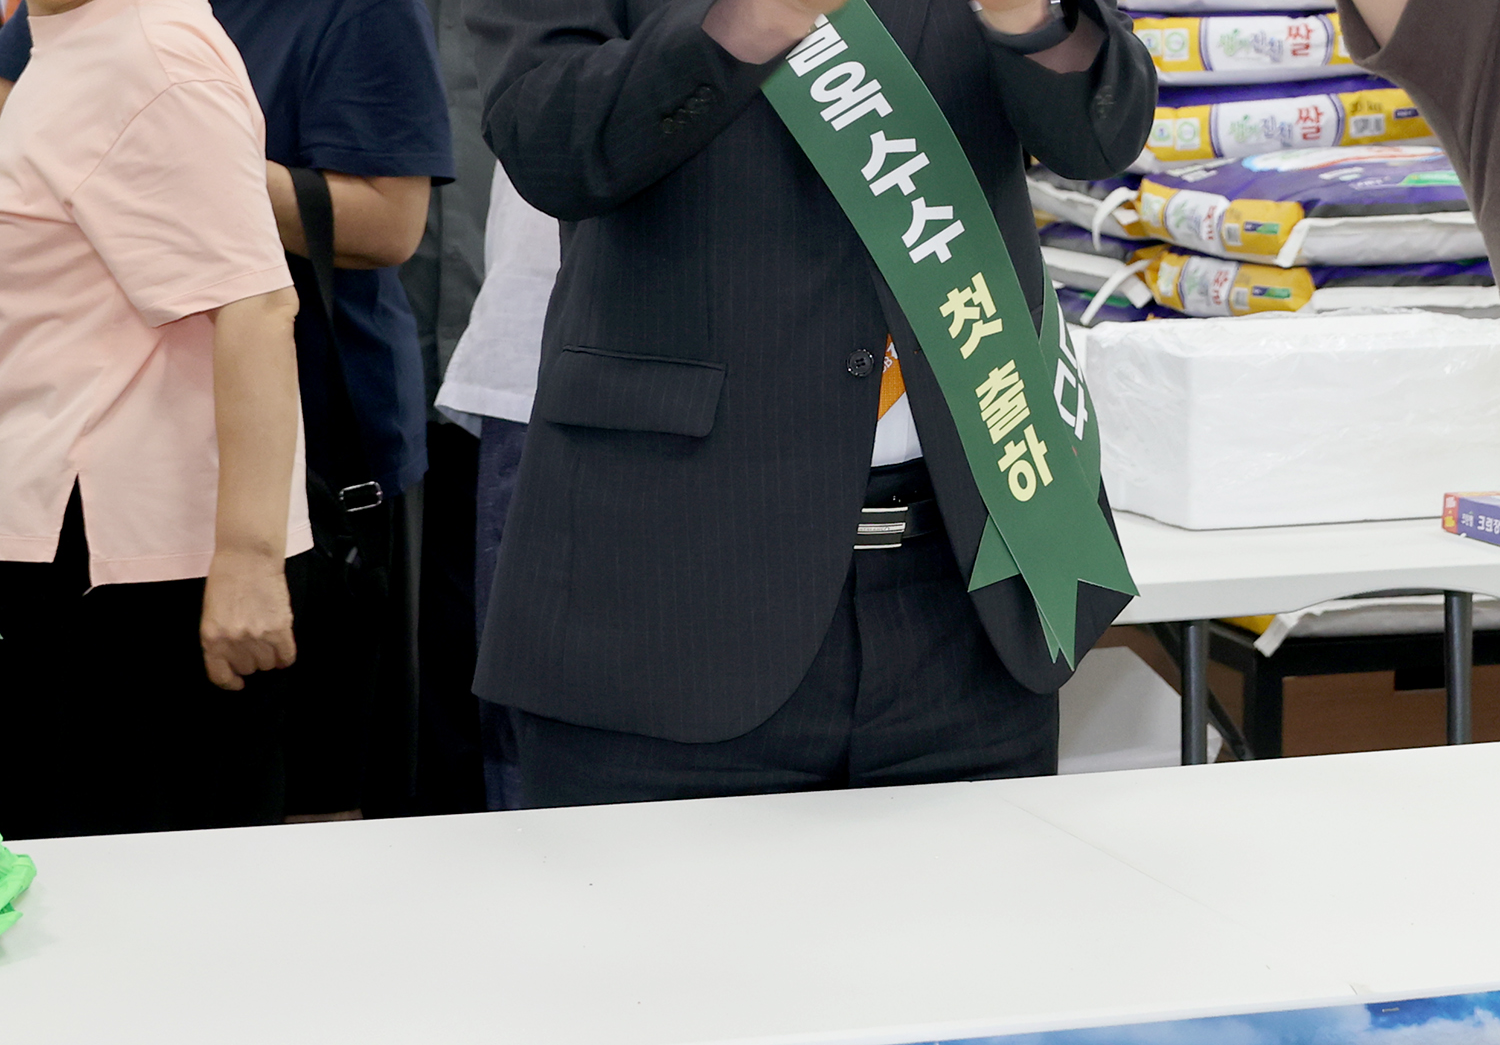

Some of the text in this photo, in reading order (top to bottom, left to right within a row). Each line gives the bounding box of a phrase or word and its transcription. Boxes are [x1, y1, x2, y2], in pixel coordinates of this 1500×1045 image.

[1286, 23, 1316, 57] 쌀
[1295, 105, 1324, 141] 쌀
[938, 271, 1003, 360] 첫
[975, 360, 1054, 503] 출하
